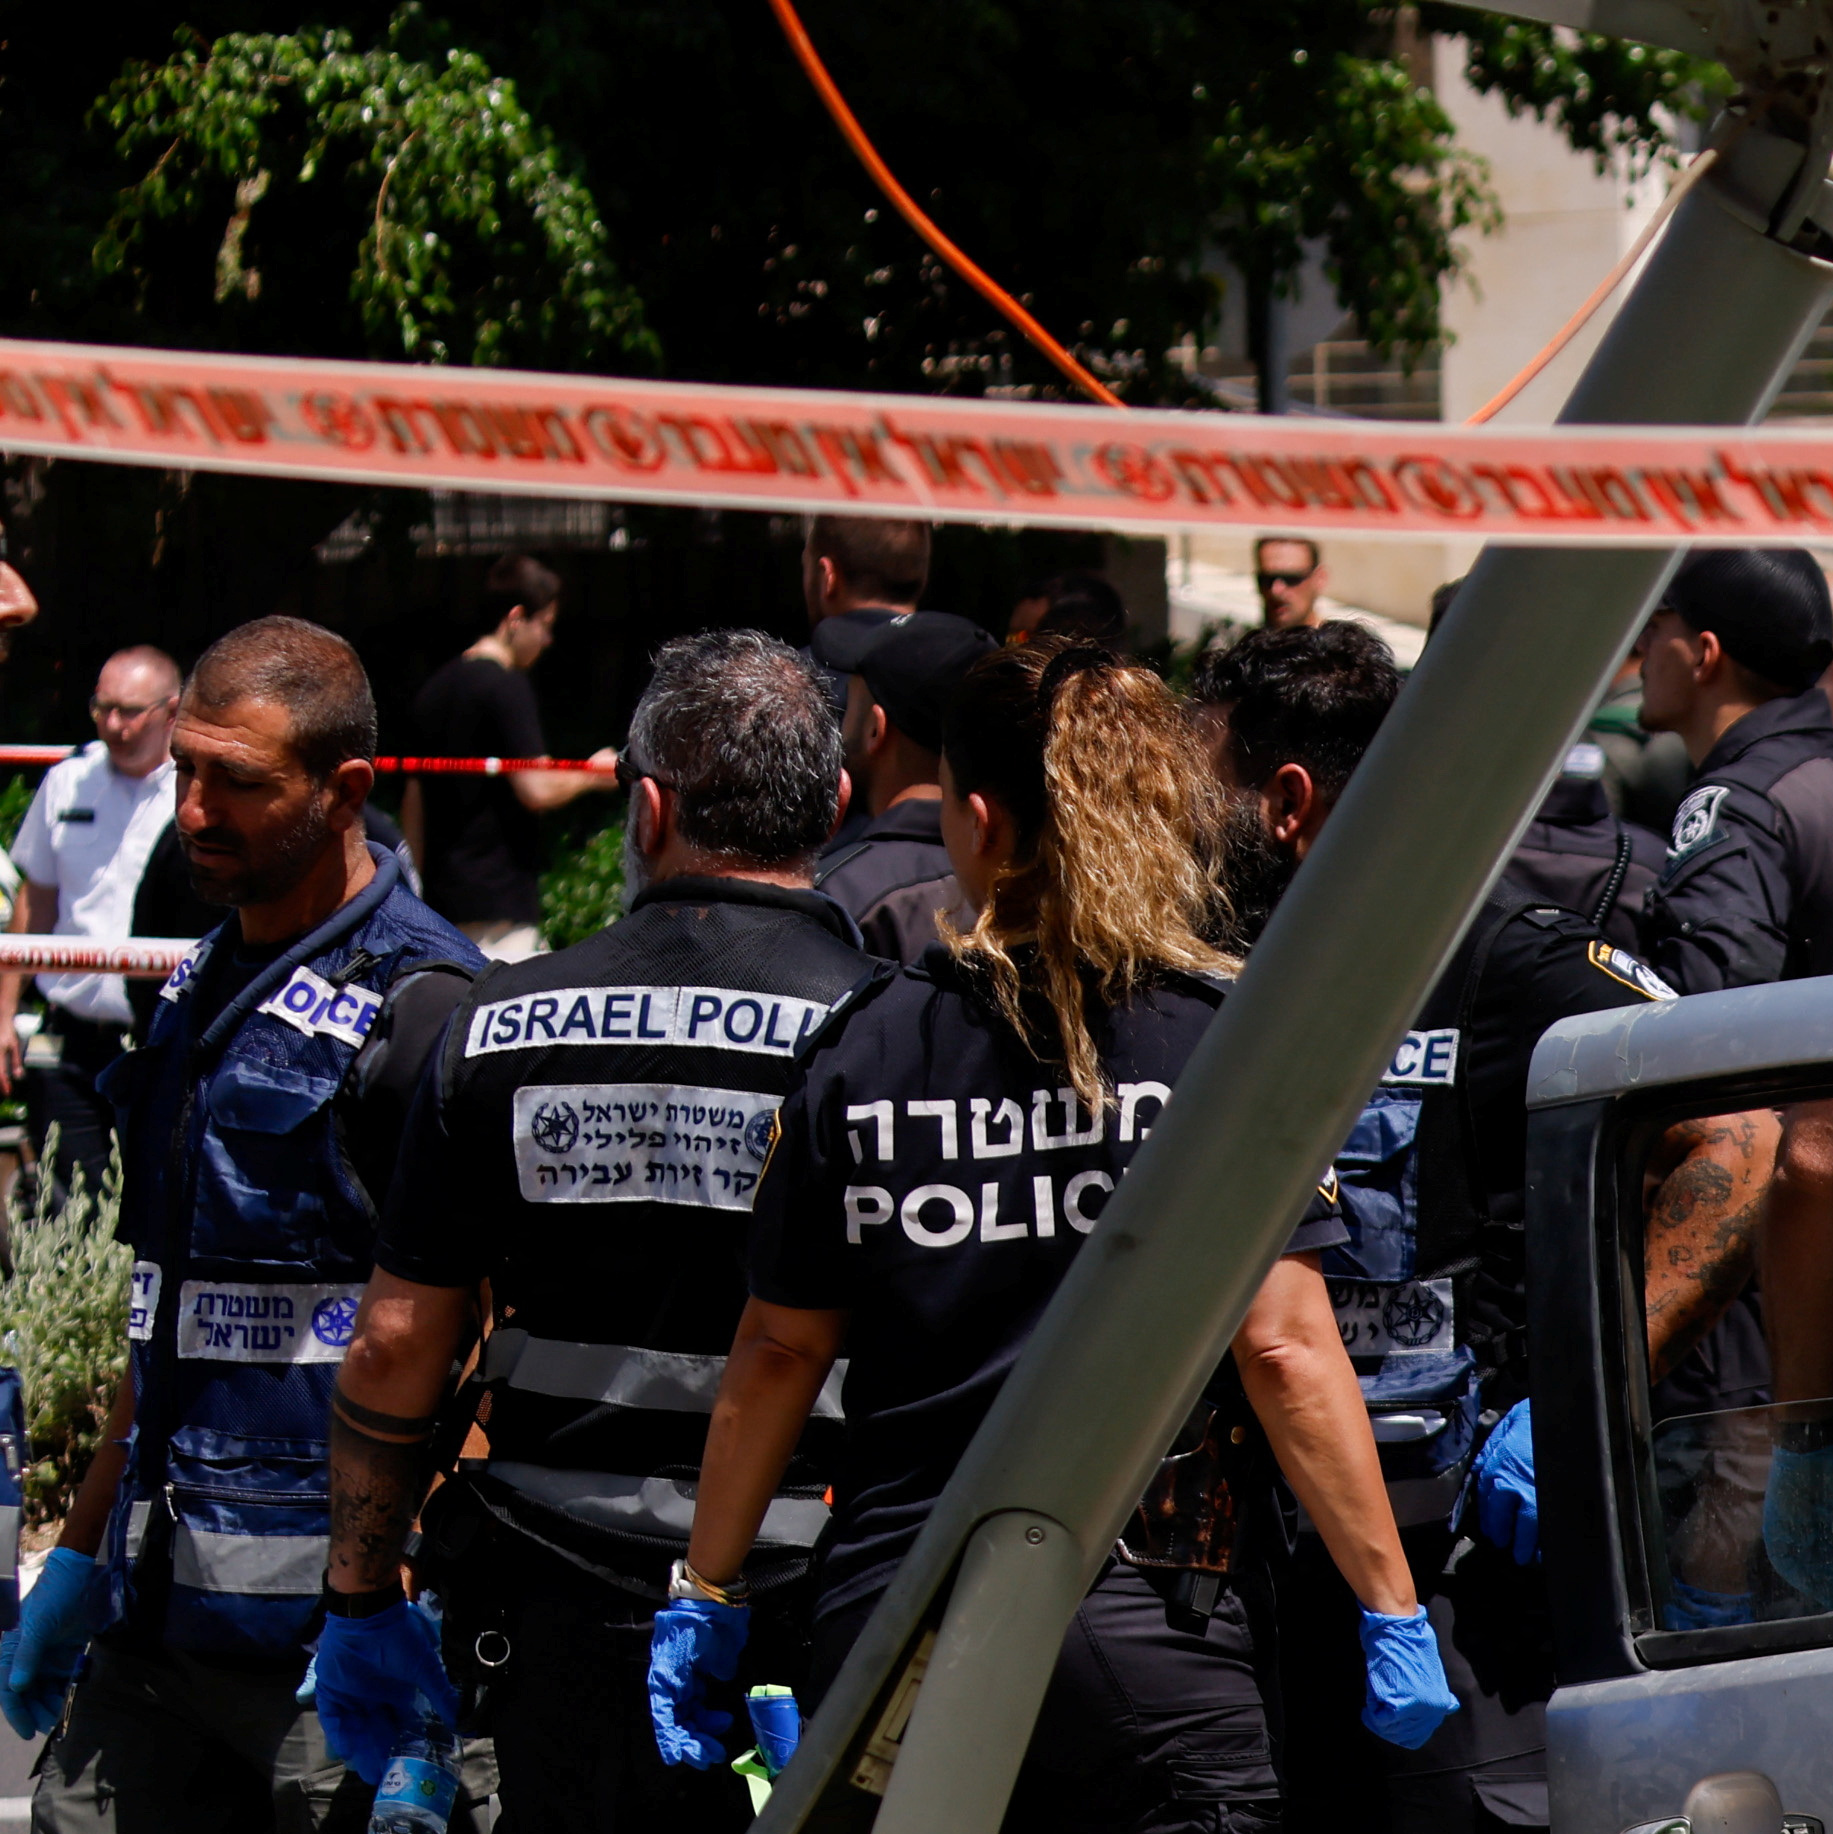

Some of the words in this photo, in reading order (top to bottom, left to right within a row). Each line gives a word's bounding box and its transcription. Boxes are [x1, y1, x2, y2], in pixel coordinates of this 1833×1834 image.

[480, 994, 666, 1048] ISRAEL
[688, 995, 814, 1048] POLI
[583, 1100, 658, 1126] ישראל
[665, 1103, 744, 1129] משטרת
[846, 1080, 1173, 1164] משטרה
[584, 1128, 666, 1150] פלילי
[673, 1131, 742, 1155] זיהוי
[536, 1160, 634, 1187] עבירה
[844, 1168, 1132, 1248] POLIC
[193, 1292, 294, 1318] משטרת
[198, 1318, 295, 1350] ישראל
